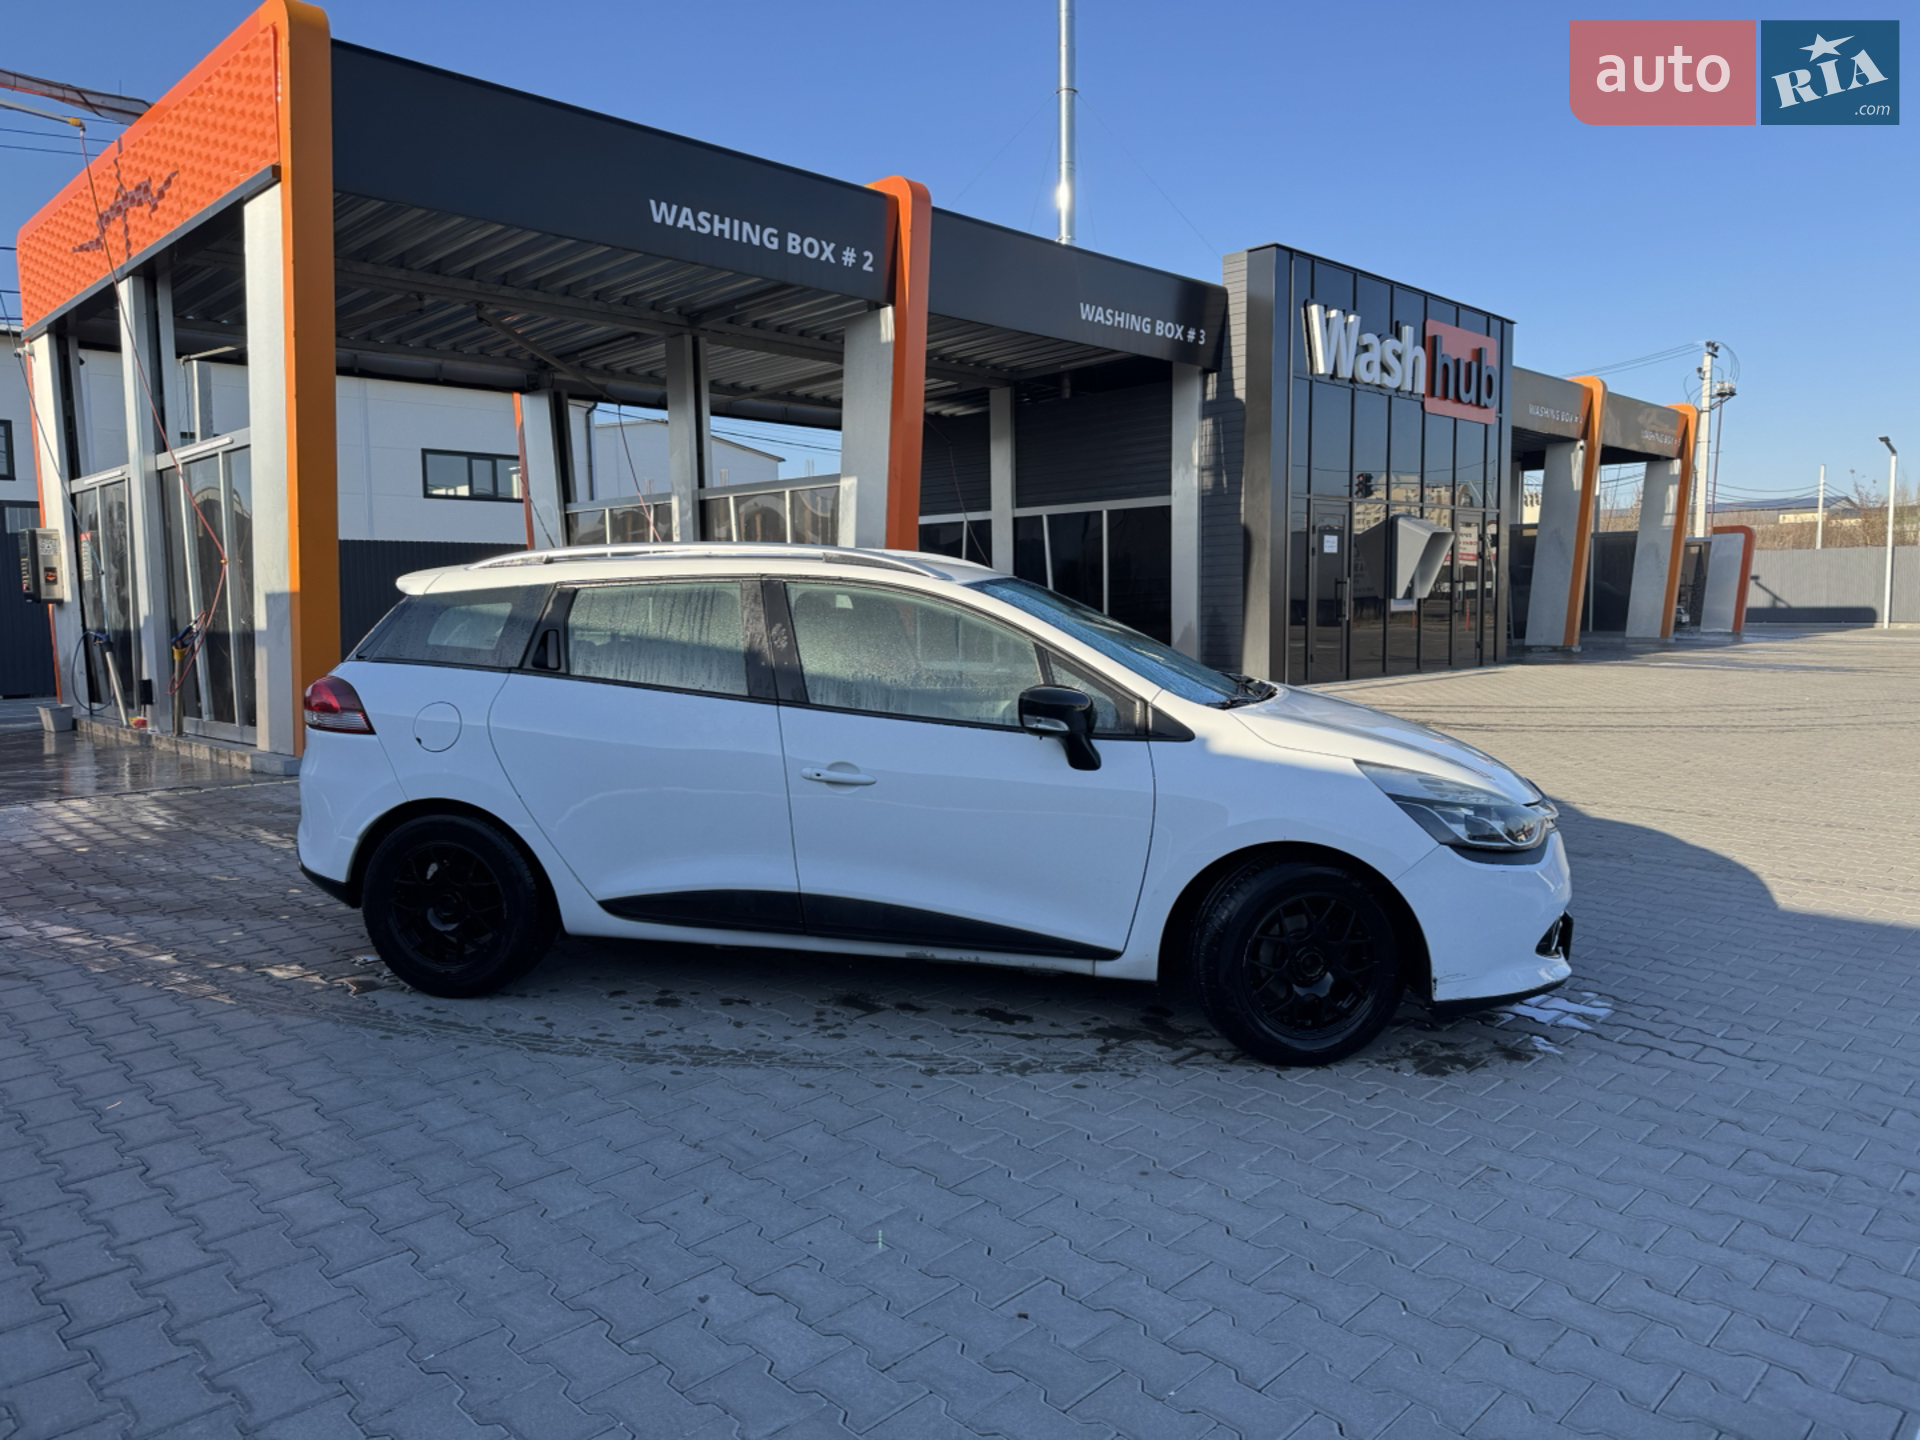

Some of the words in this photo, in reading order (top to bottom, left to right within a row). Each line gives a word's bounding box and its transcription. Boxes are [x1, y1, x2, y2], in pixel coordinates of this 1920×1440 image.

[649, 199, 779, 250] WASHING
[787, 232, 836, 264] BOX
[842, 246, 857, 268] #
[862, 250, 875, 272] 2
[1079, 302, 1151, 334] WASHING
[1155, 319, 1185, 341] BOX
[1186, 327, 1196, 343] #
[1198, 329, 1206, 345] 3
[1306, 303, 1427, 394] Wash
